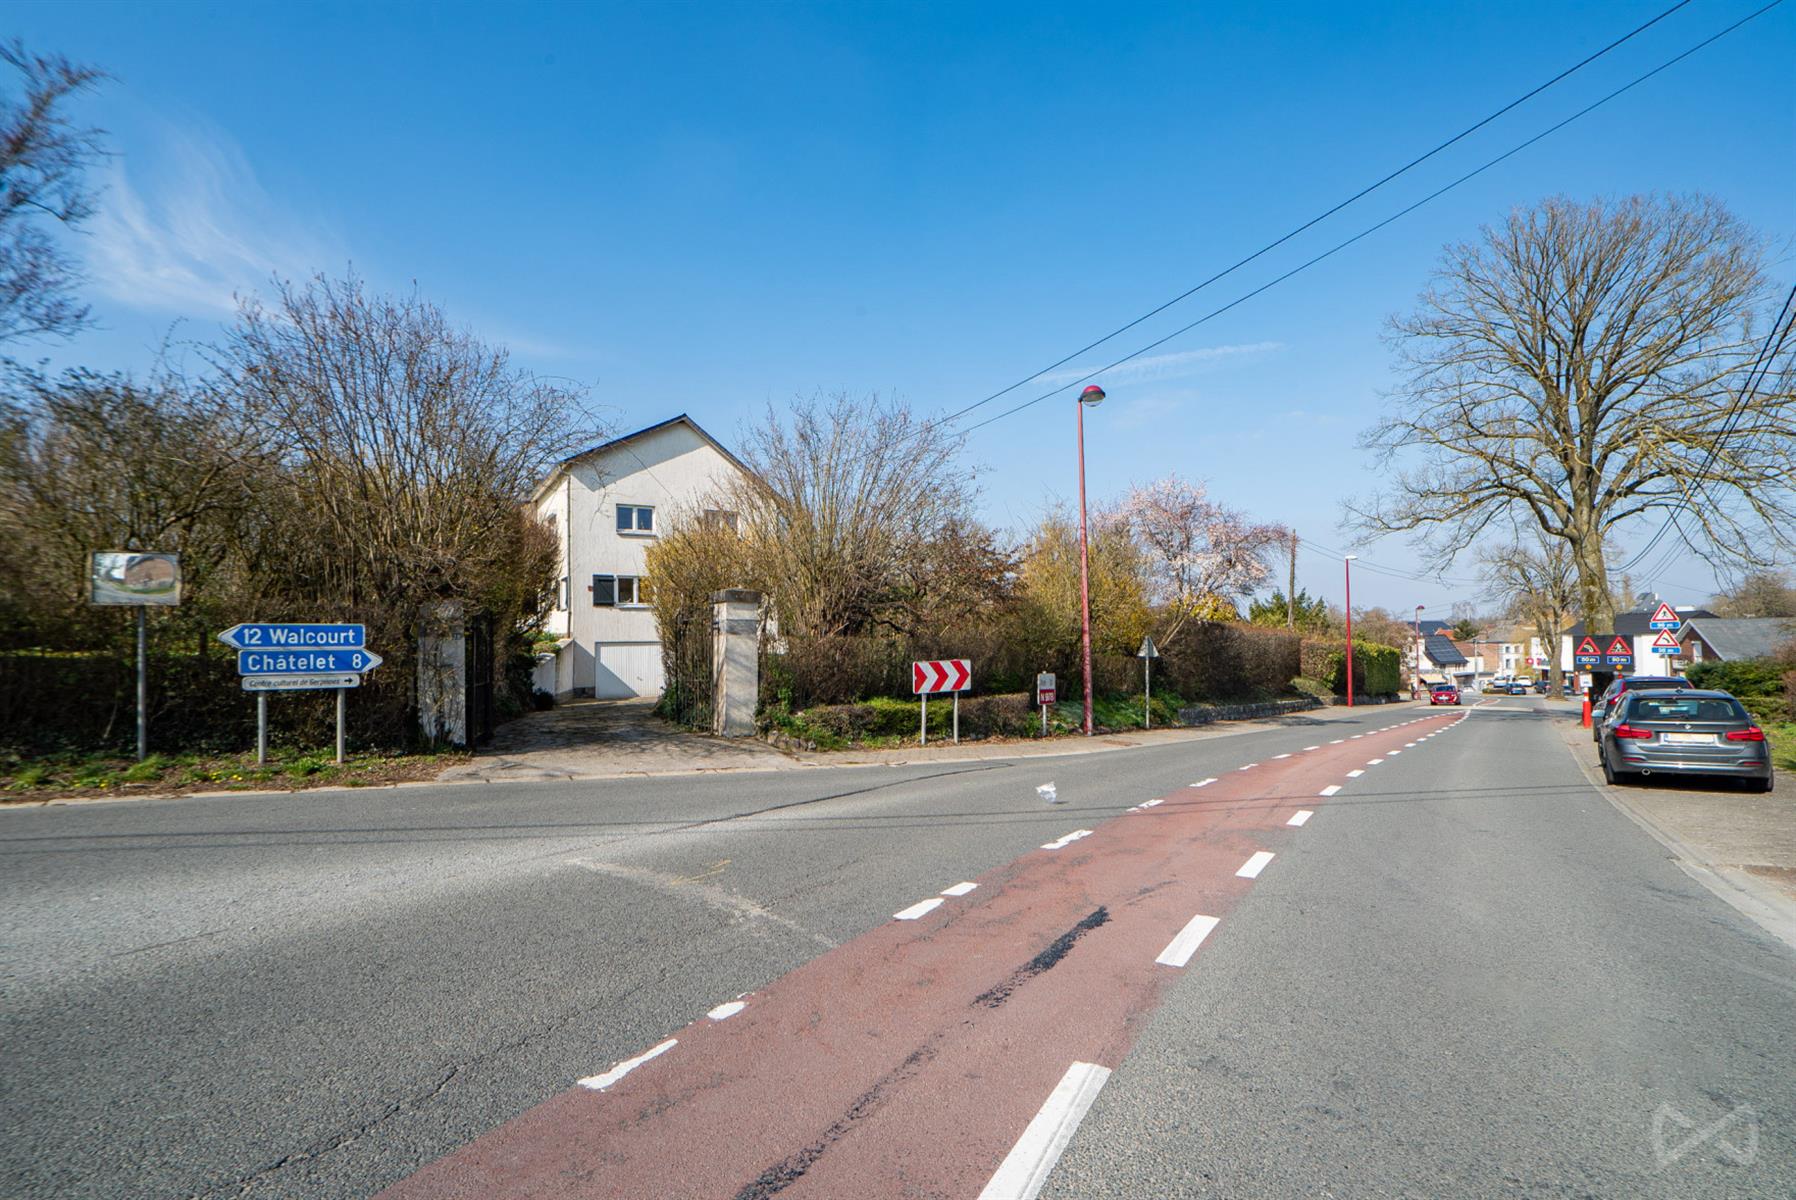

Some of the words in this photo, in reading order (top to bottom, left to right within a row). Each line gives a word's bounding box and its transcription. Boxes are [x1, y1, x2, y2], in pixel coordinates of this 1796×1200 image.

[243, 628, 262, 645] 12
[269, 628, 356, 644] Walcourt
[247, 653, 336, 671] Châtelet
[352, 653, 363, 669] 8
[248, 679, 272, 688] Centre
[273, 679, 299, 687] culturel
[299, 678, 308, 687] de
